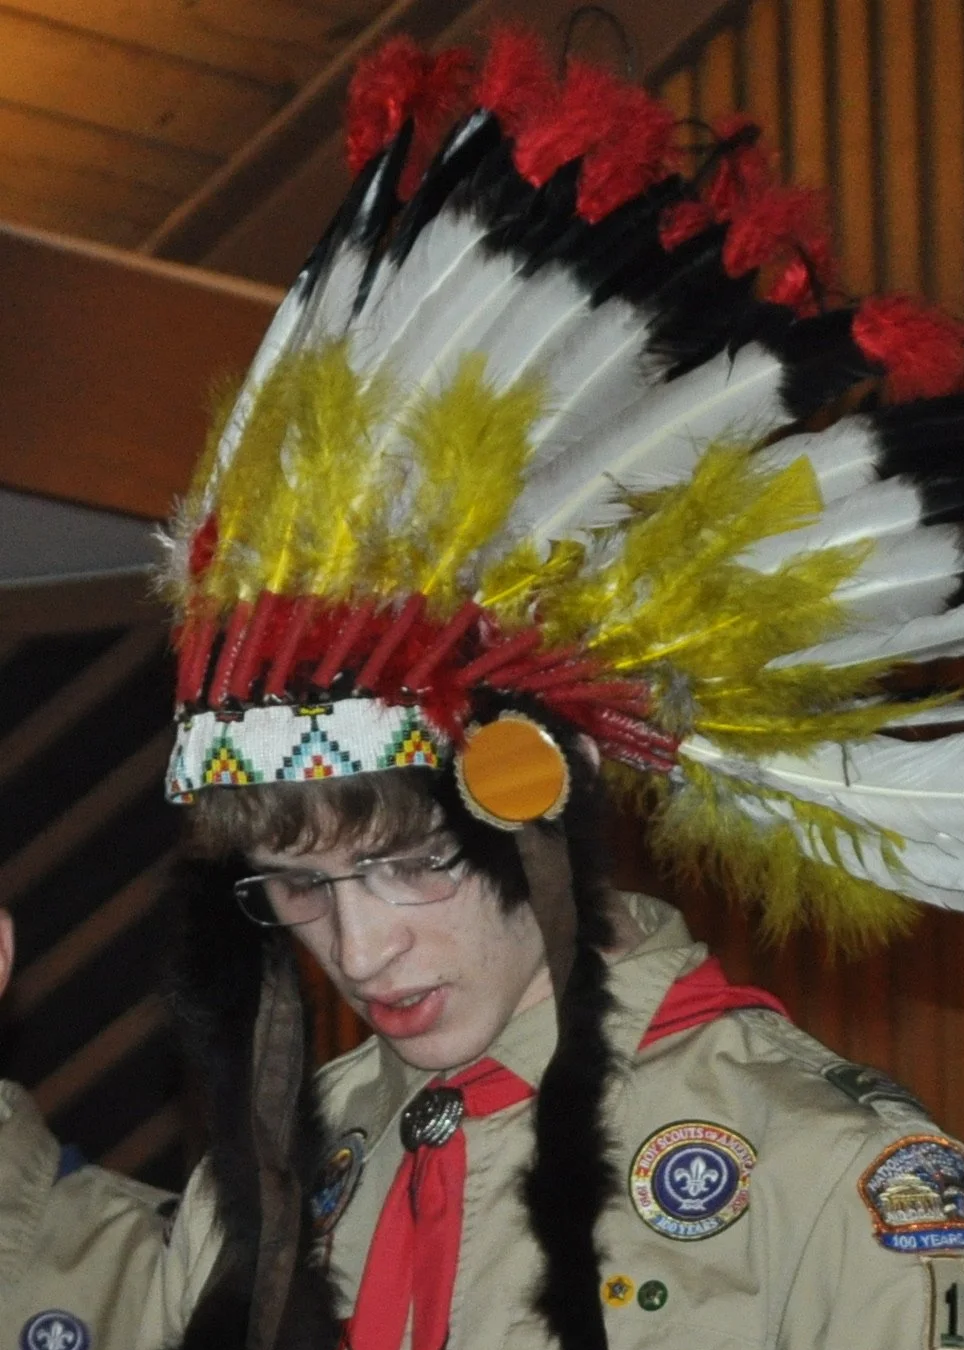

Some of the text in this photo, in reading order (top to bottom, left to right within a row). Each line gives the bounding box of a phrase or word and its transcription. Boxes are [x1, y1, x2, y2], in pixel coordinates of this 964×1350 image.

[640, 1145, 660, 1170] BOY
[660, 1127, 704, 1147] SCOUTS
[892, 1234, 917, 1249] 100
